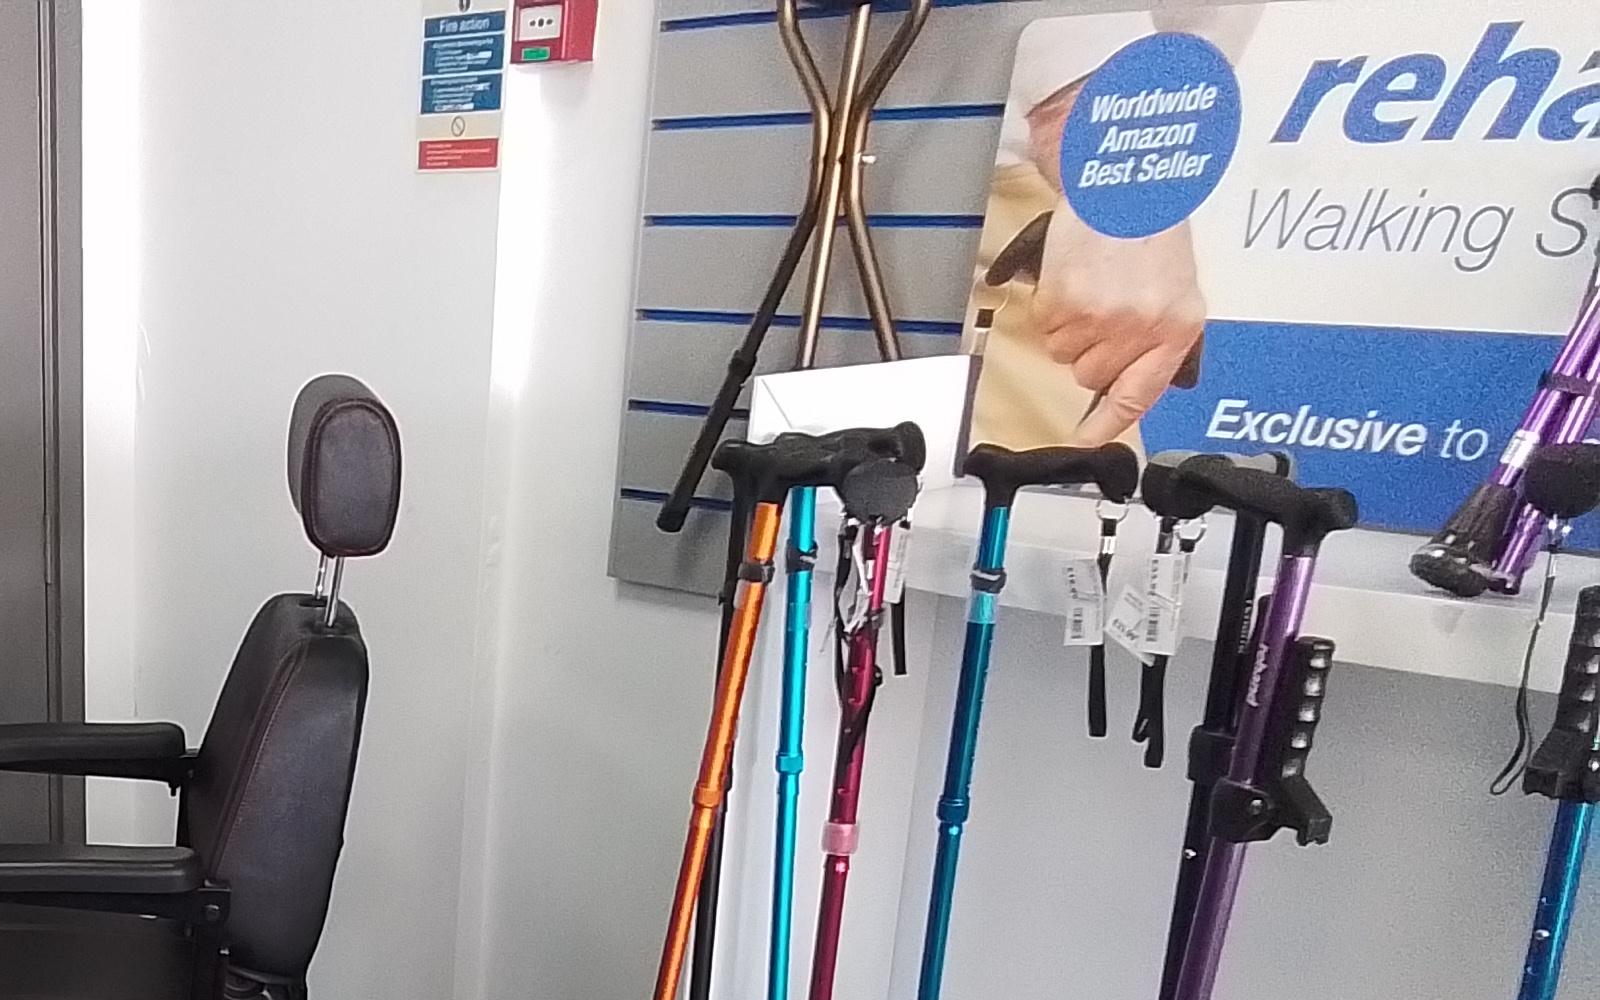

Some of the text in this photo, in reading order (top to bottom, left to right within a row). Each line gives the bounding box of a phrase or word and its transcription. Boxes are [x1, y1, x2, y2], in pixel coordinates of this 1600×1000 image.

[1090, 82, 1218, 124] Worldwide
[1097, 121, 1199, 154] Amazon
[1077, 150, 1213, 188] Best Seller
[1244, 188, 1515, 272] Walking
[1205, 399, 1489, 462] Exclusive to
